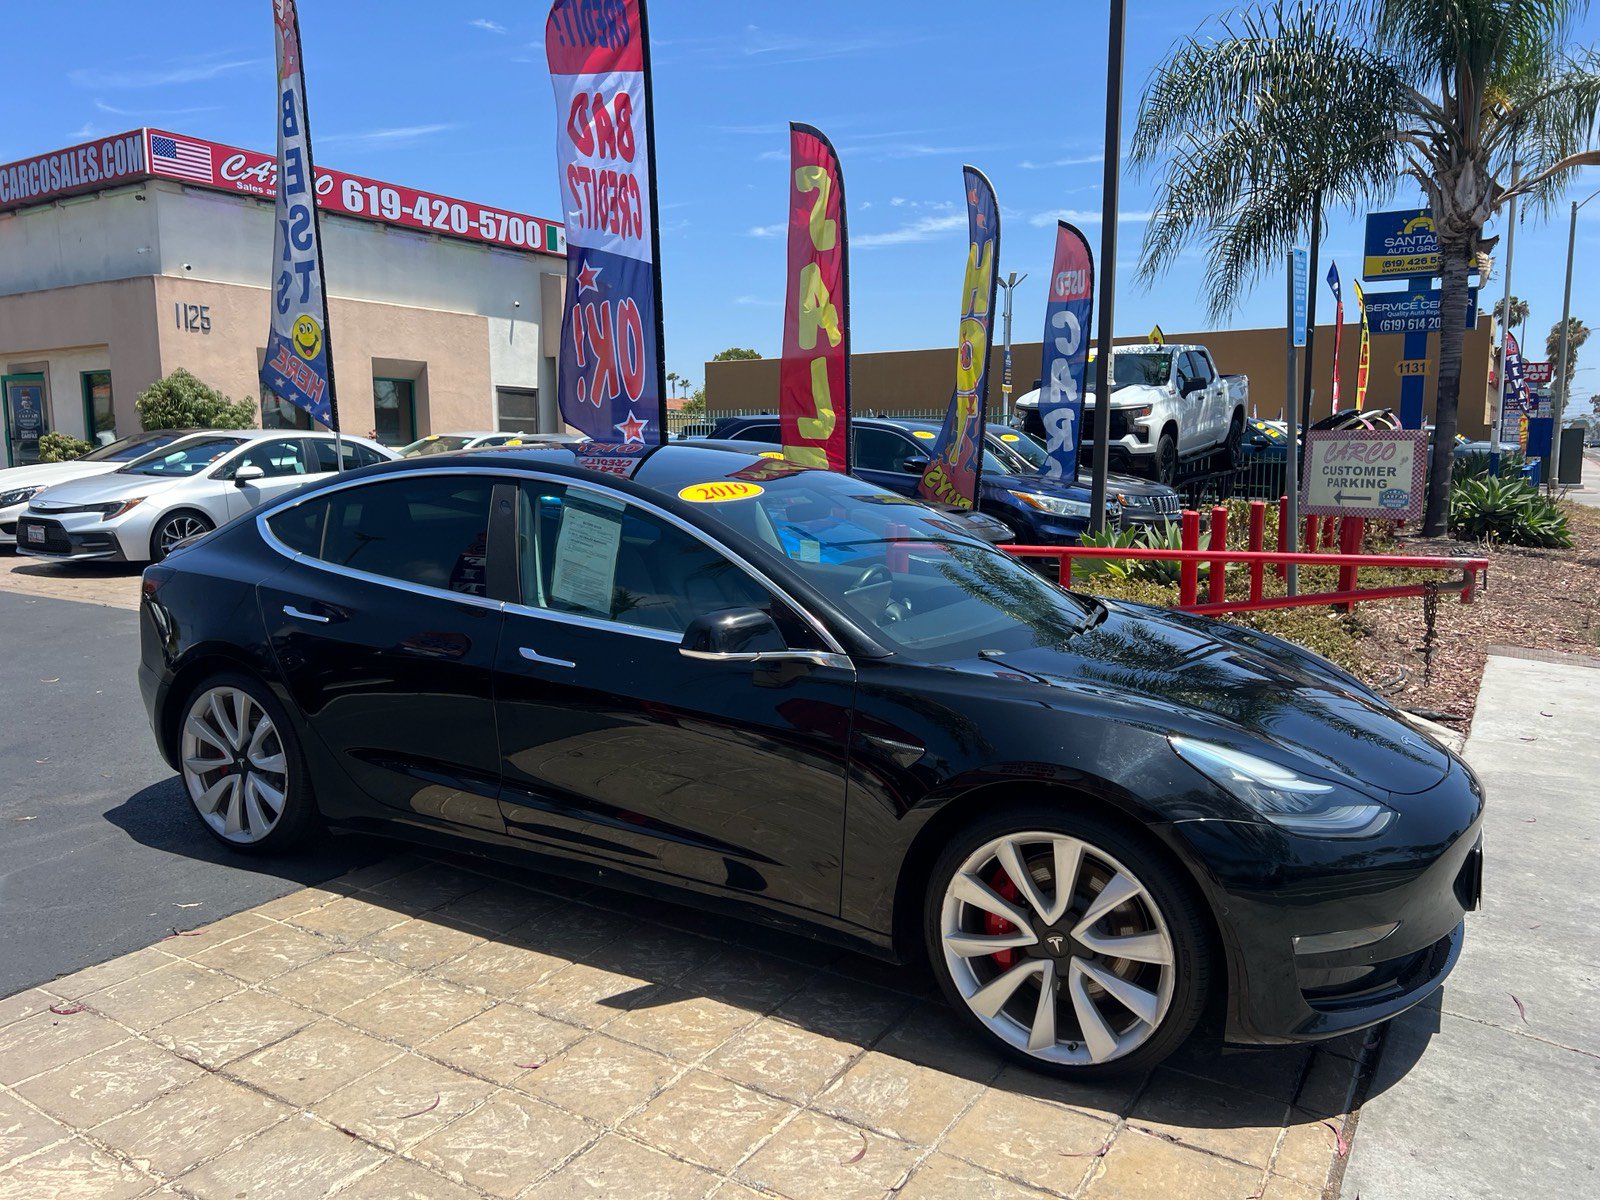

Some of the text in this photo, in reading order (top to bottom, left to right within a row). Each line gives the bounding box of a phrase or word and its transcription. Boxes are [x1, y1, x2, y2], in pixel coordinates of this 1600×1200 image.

[0, 135, 143, 203] CARCOSALES.COM
[236, 182, 264, 194] Sales
[342, 179, 541, 249] 619-420-5700
[1384, 235, 1438, 247] SANTA
[1387, 244, 1439, 254] AUTO GRO
[1382, 259, 1405, 268] (619)
[1407, 257, 1427, 265] 426
[1365, 301, 1419, 312] SERVICE
[175, 302, 211, 334] 1125
[1380, 319, 1405, 331] (619)
[1407, 318, 1426, 330] 614
[1398, 362, 1425, 373] 1131
[1323, 441, 1397, 464] CARCO
[1322, 466, 1397, 477] CUSTOMER
[1327, 478, 1388, 489] PARKING
[696, 484, 749, 500] 2019
